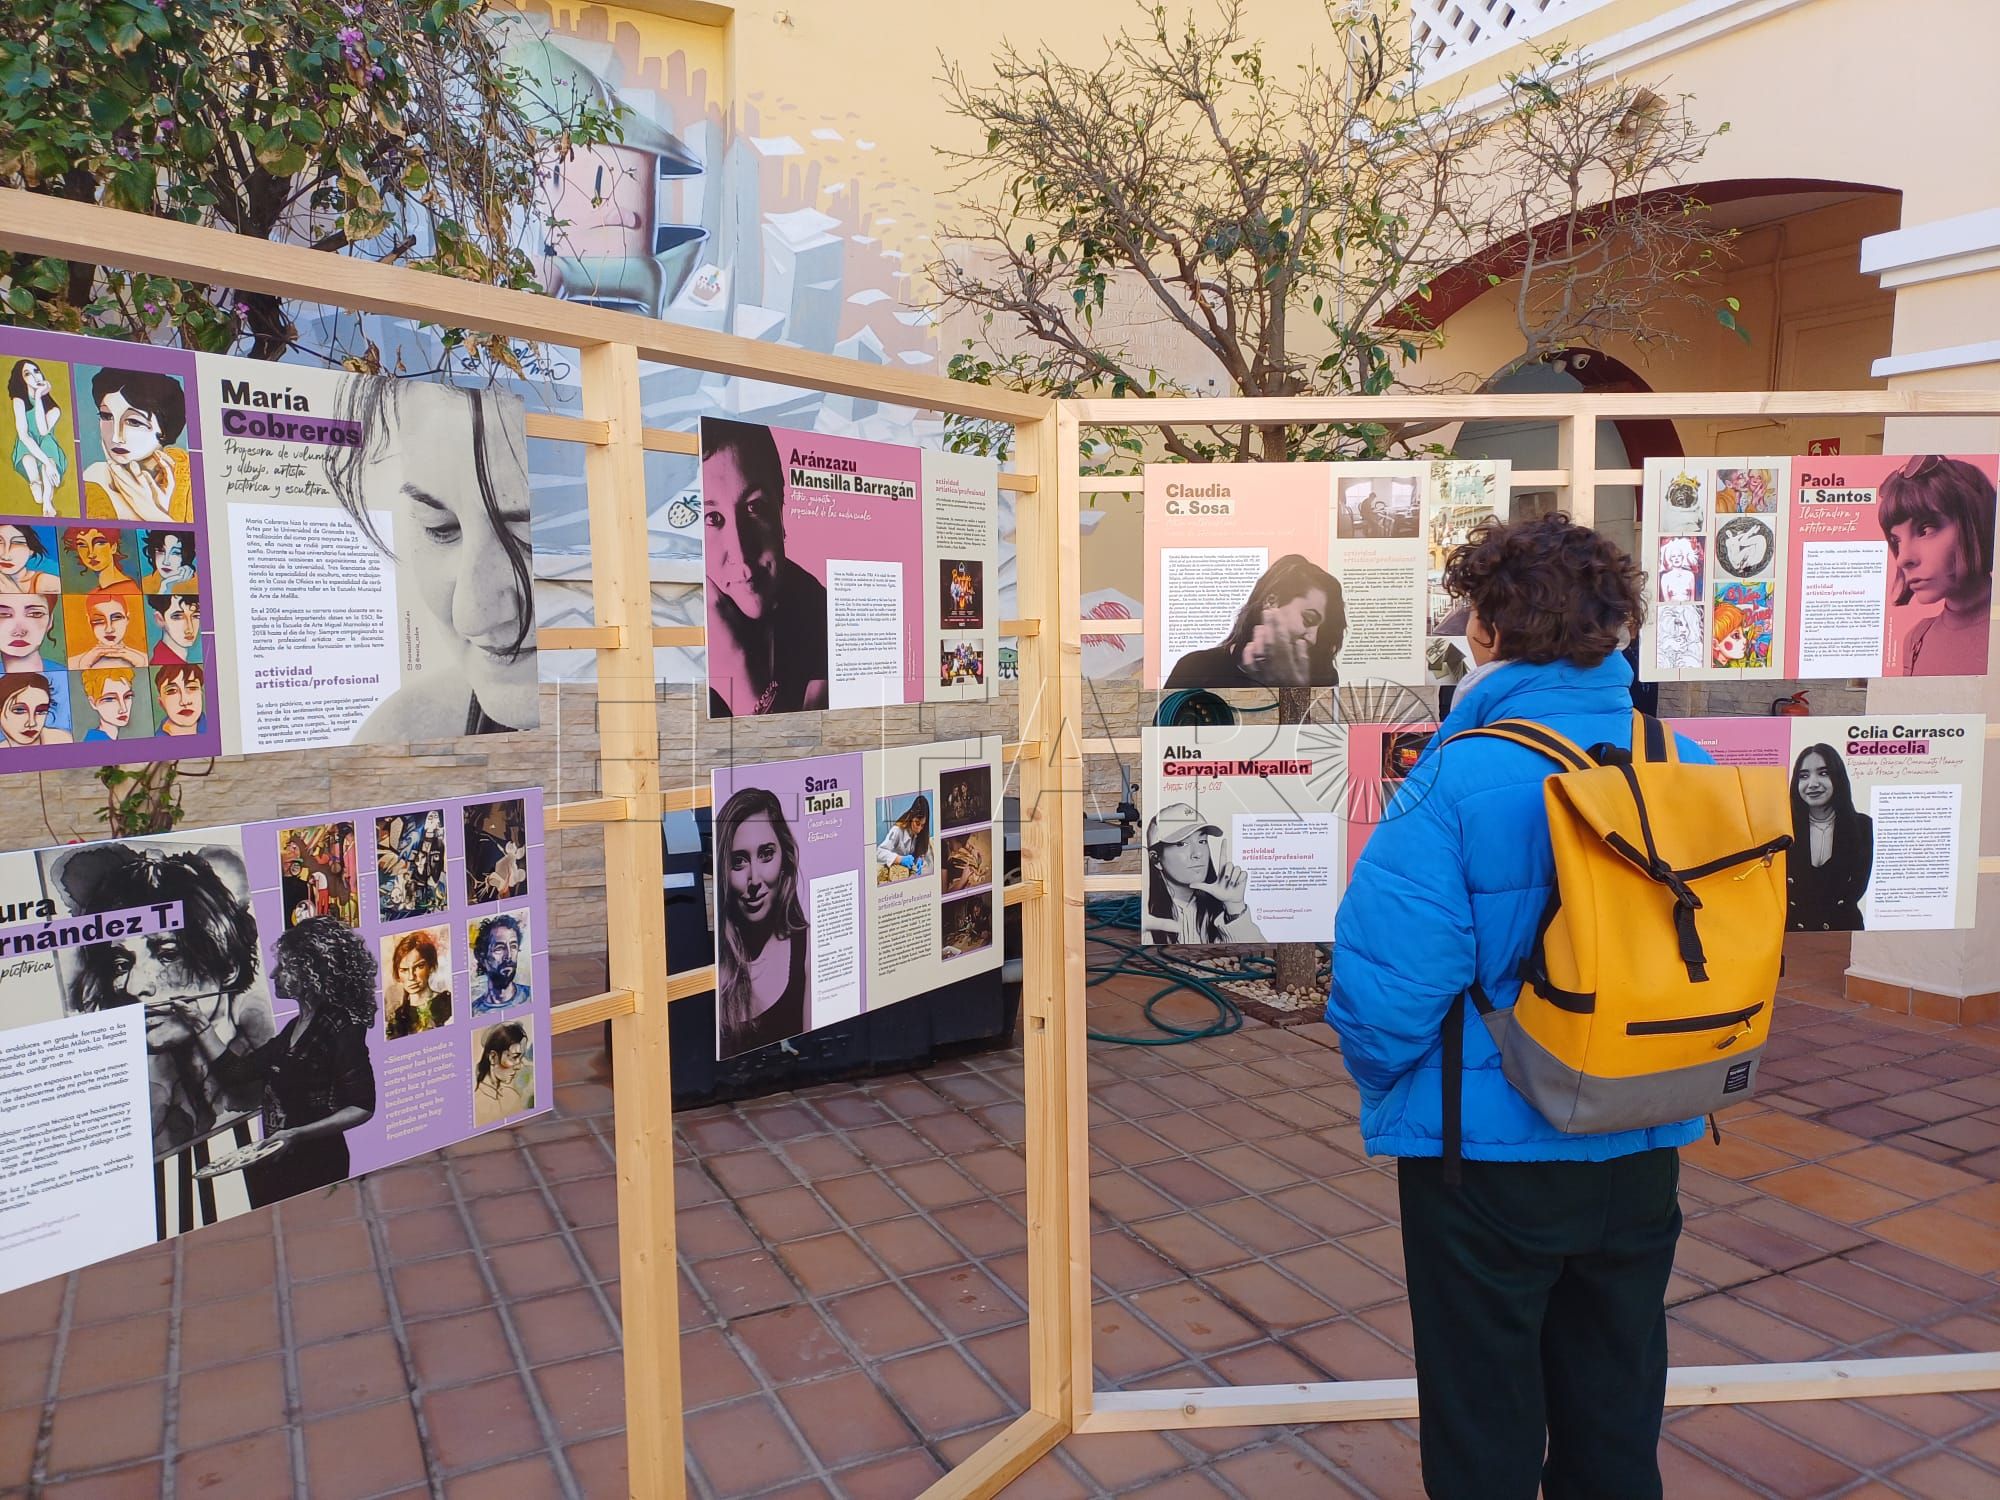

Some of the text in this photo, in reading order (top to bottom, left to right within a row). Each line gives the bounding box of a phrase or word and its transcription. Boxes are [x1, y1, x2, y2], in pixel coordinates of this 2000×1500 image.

[221, 378, 309, 412] María
[222, 410, 361, 445] Cobreros
[224, 439, 274, 461] Profesora
[278, 445, 291, 459] de
[790, 448, 857, 473] Aránzazu
[221, 459, 306, 480] y dibujo, artista
[790, 469, 914, 501] Mansilla Barragán
[1801, 473, 1845, 487] Paola
[272, 486, 283, 499] y
[1165, 483, 1231, 498] Claudia
[1801, 490, 1872, 503] I. Santos
[1188, 500, 1230, 515] Sosa
[1853, 510, 1860, 521] y
[255, 665, 313, 677] actividad
[1847, 725, 1964, 739] Celia Carrasco
[1164, 746, 1202, 759] Alba
[1847, 741, 1926, 755] Cedecelia
[1163, 760, 1309, 778] Carvajal Migallón
[805, 776, 838, 793] Sara
[805, 793, 844, 815] Tapia
[151, 903, 179, 929] T.
